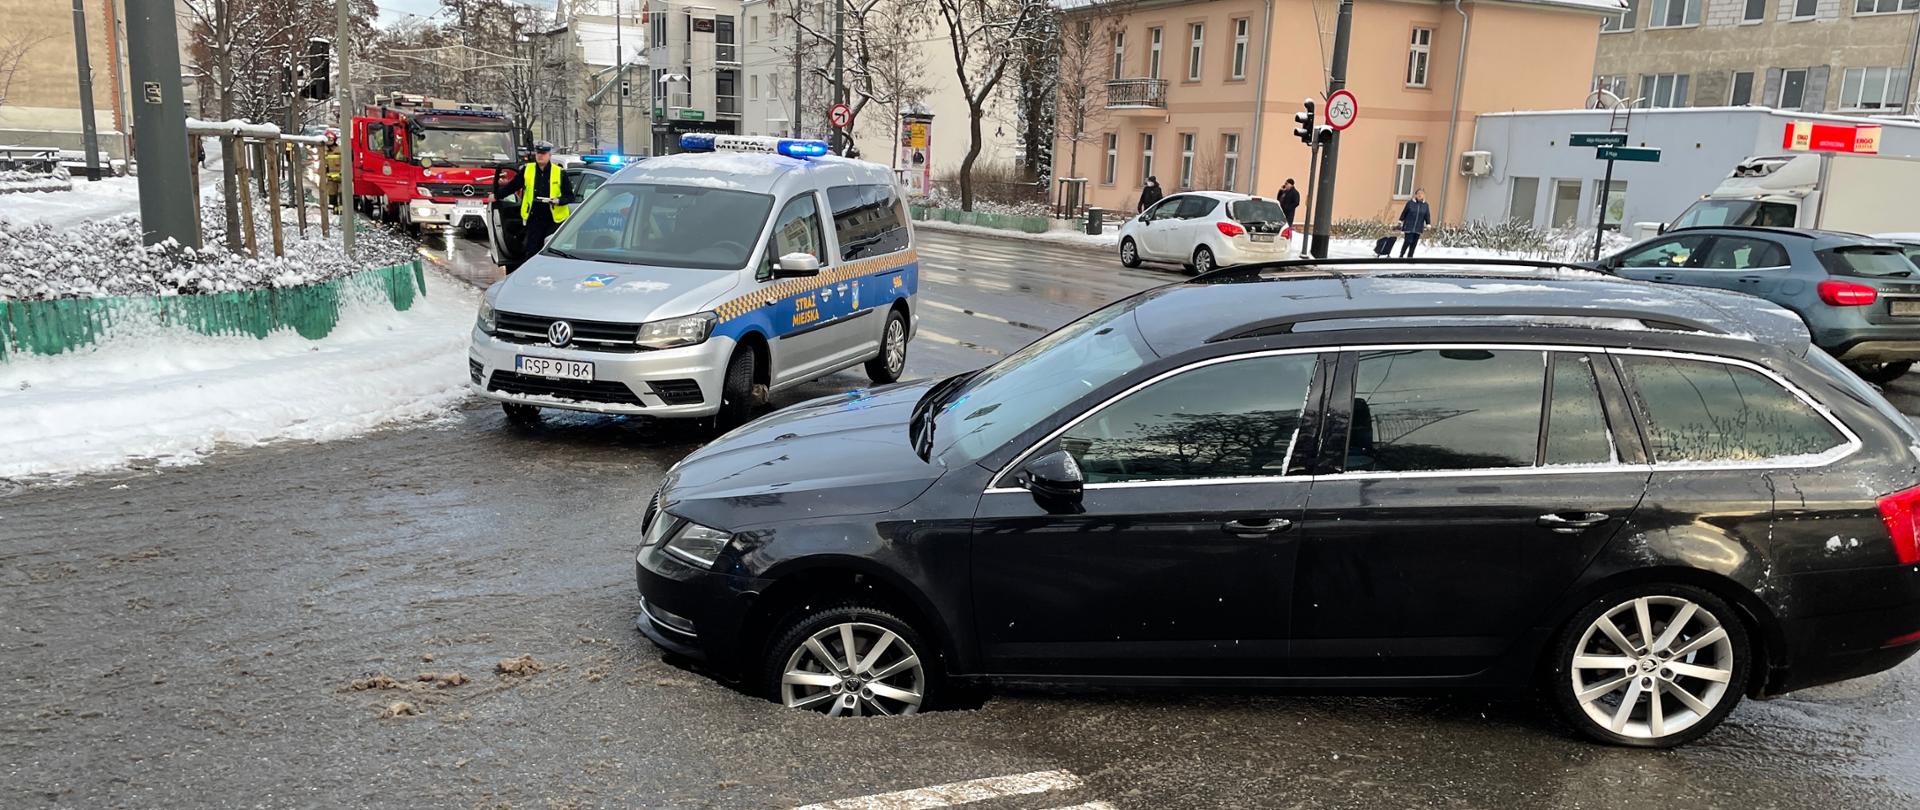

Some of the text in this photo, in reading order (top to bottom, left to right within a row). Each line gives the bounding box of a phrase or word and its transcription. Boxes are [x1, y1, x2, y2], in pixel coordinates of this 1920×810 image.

[795, 293, 816, 311] STRAŻ
[792, 310, 819, 326] MIEJSKA
[525, 358, 549, 374] GSP
